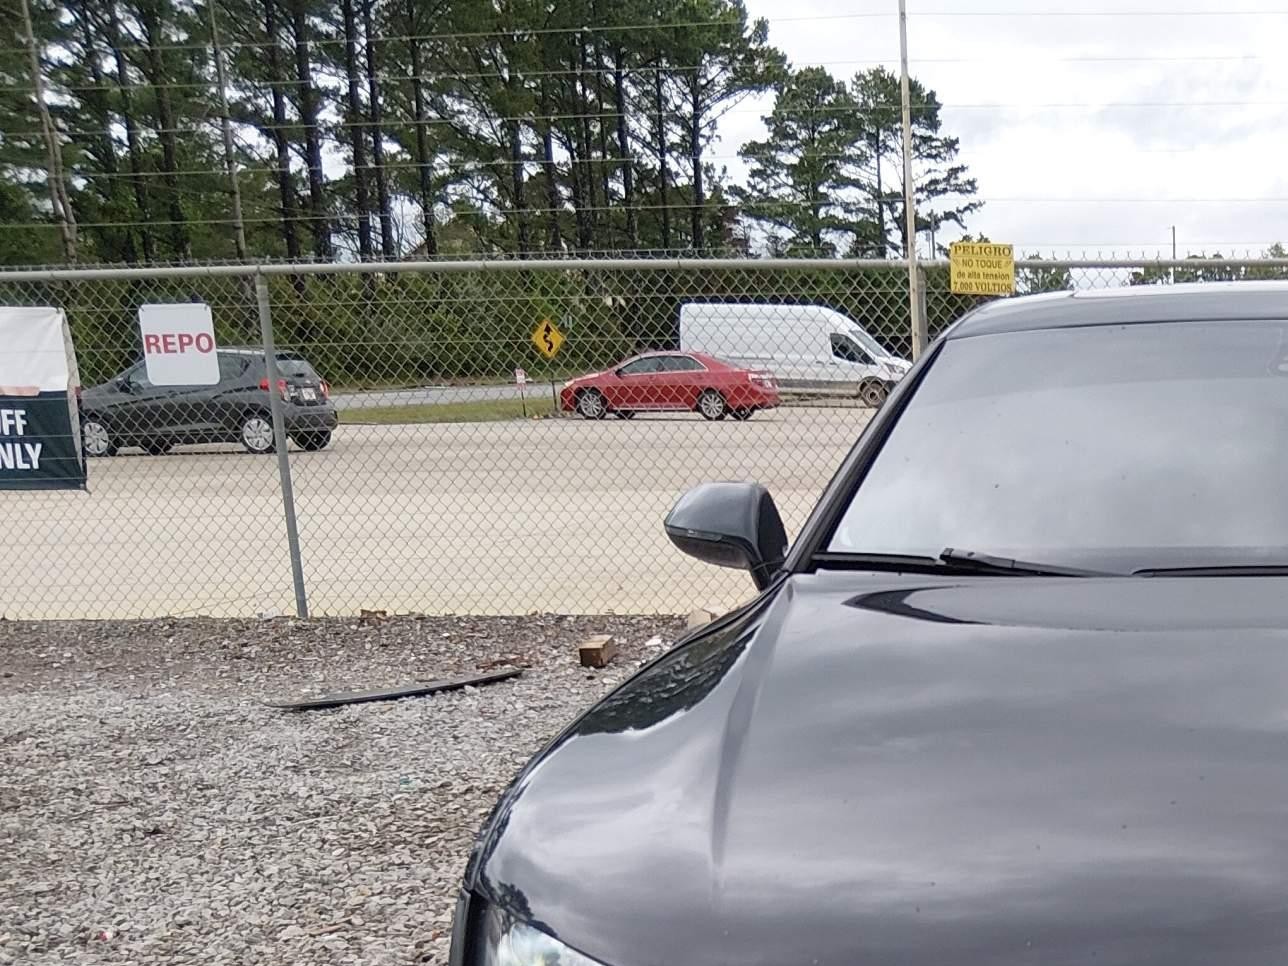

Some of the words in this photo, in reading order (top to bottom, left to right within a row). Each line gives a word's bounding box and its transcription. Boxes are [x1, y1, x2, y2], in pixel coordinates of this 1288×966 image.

[954, 245, 1011, 257] PELIGRO
[961, 259, 973, 268] NO
[975, 259, 1003, 269] TOQUE
[957, 271, 965, 279] de
[975, 282, 1012, 292] VOLTIOS
[144, 332, 214, 354] REPO
[0, 409, 27, 436] FF
